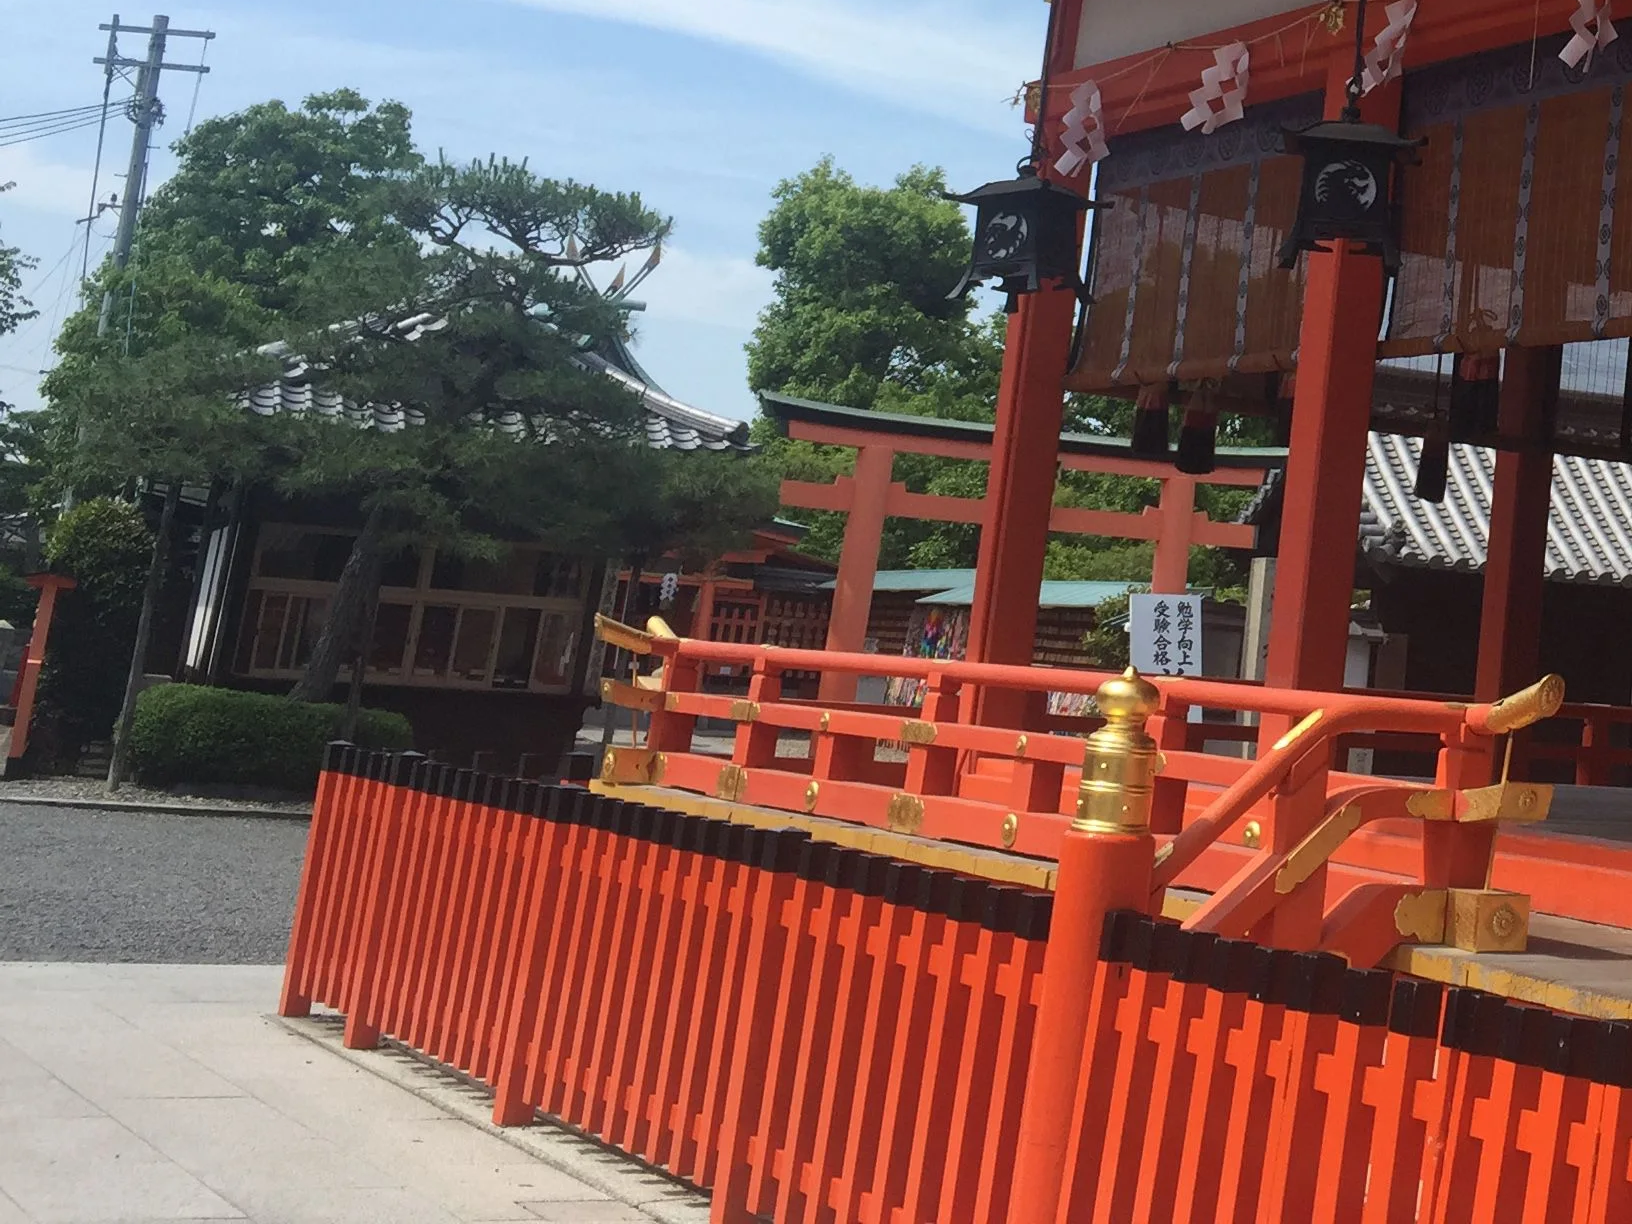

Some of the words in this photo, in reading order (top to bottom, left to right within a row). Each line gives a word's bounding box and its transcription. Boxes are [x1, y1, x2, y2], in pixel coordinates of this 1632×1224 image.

[1153, 600, 1172, 665] 受験合格
[1176, 601, 1194, 666] 勉学向上
